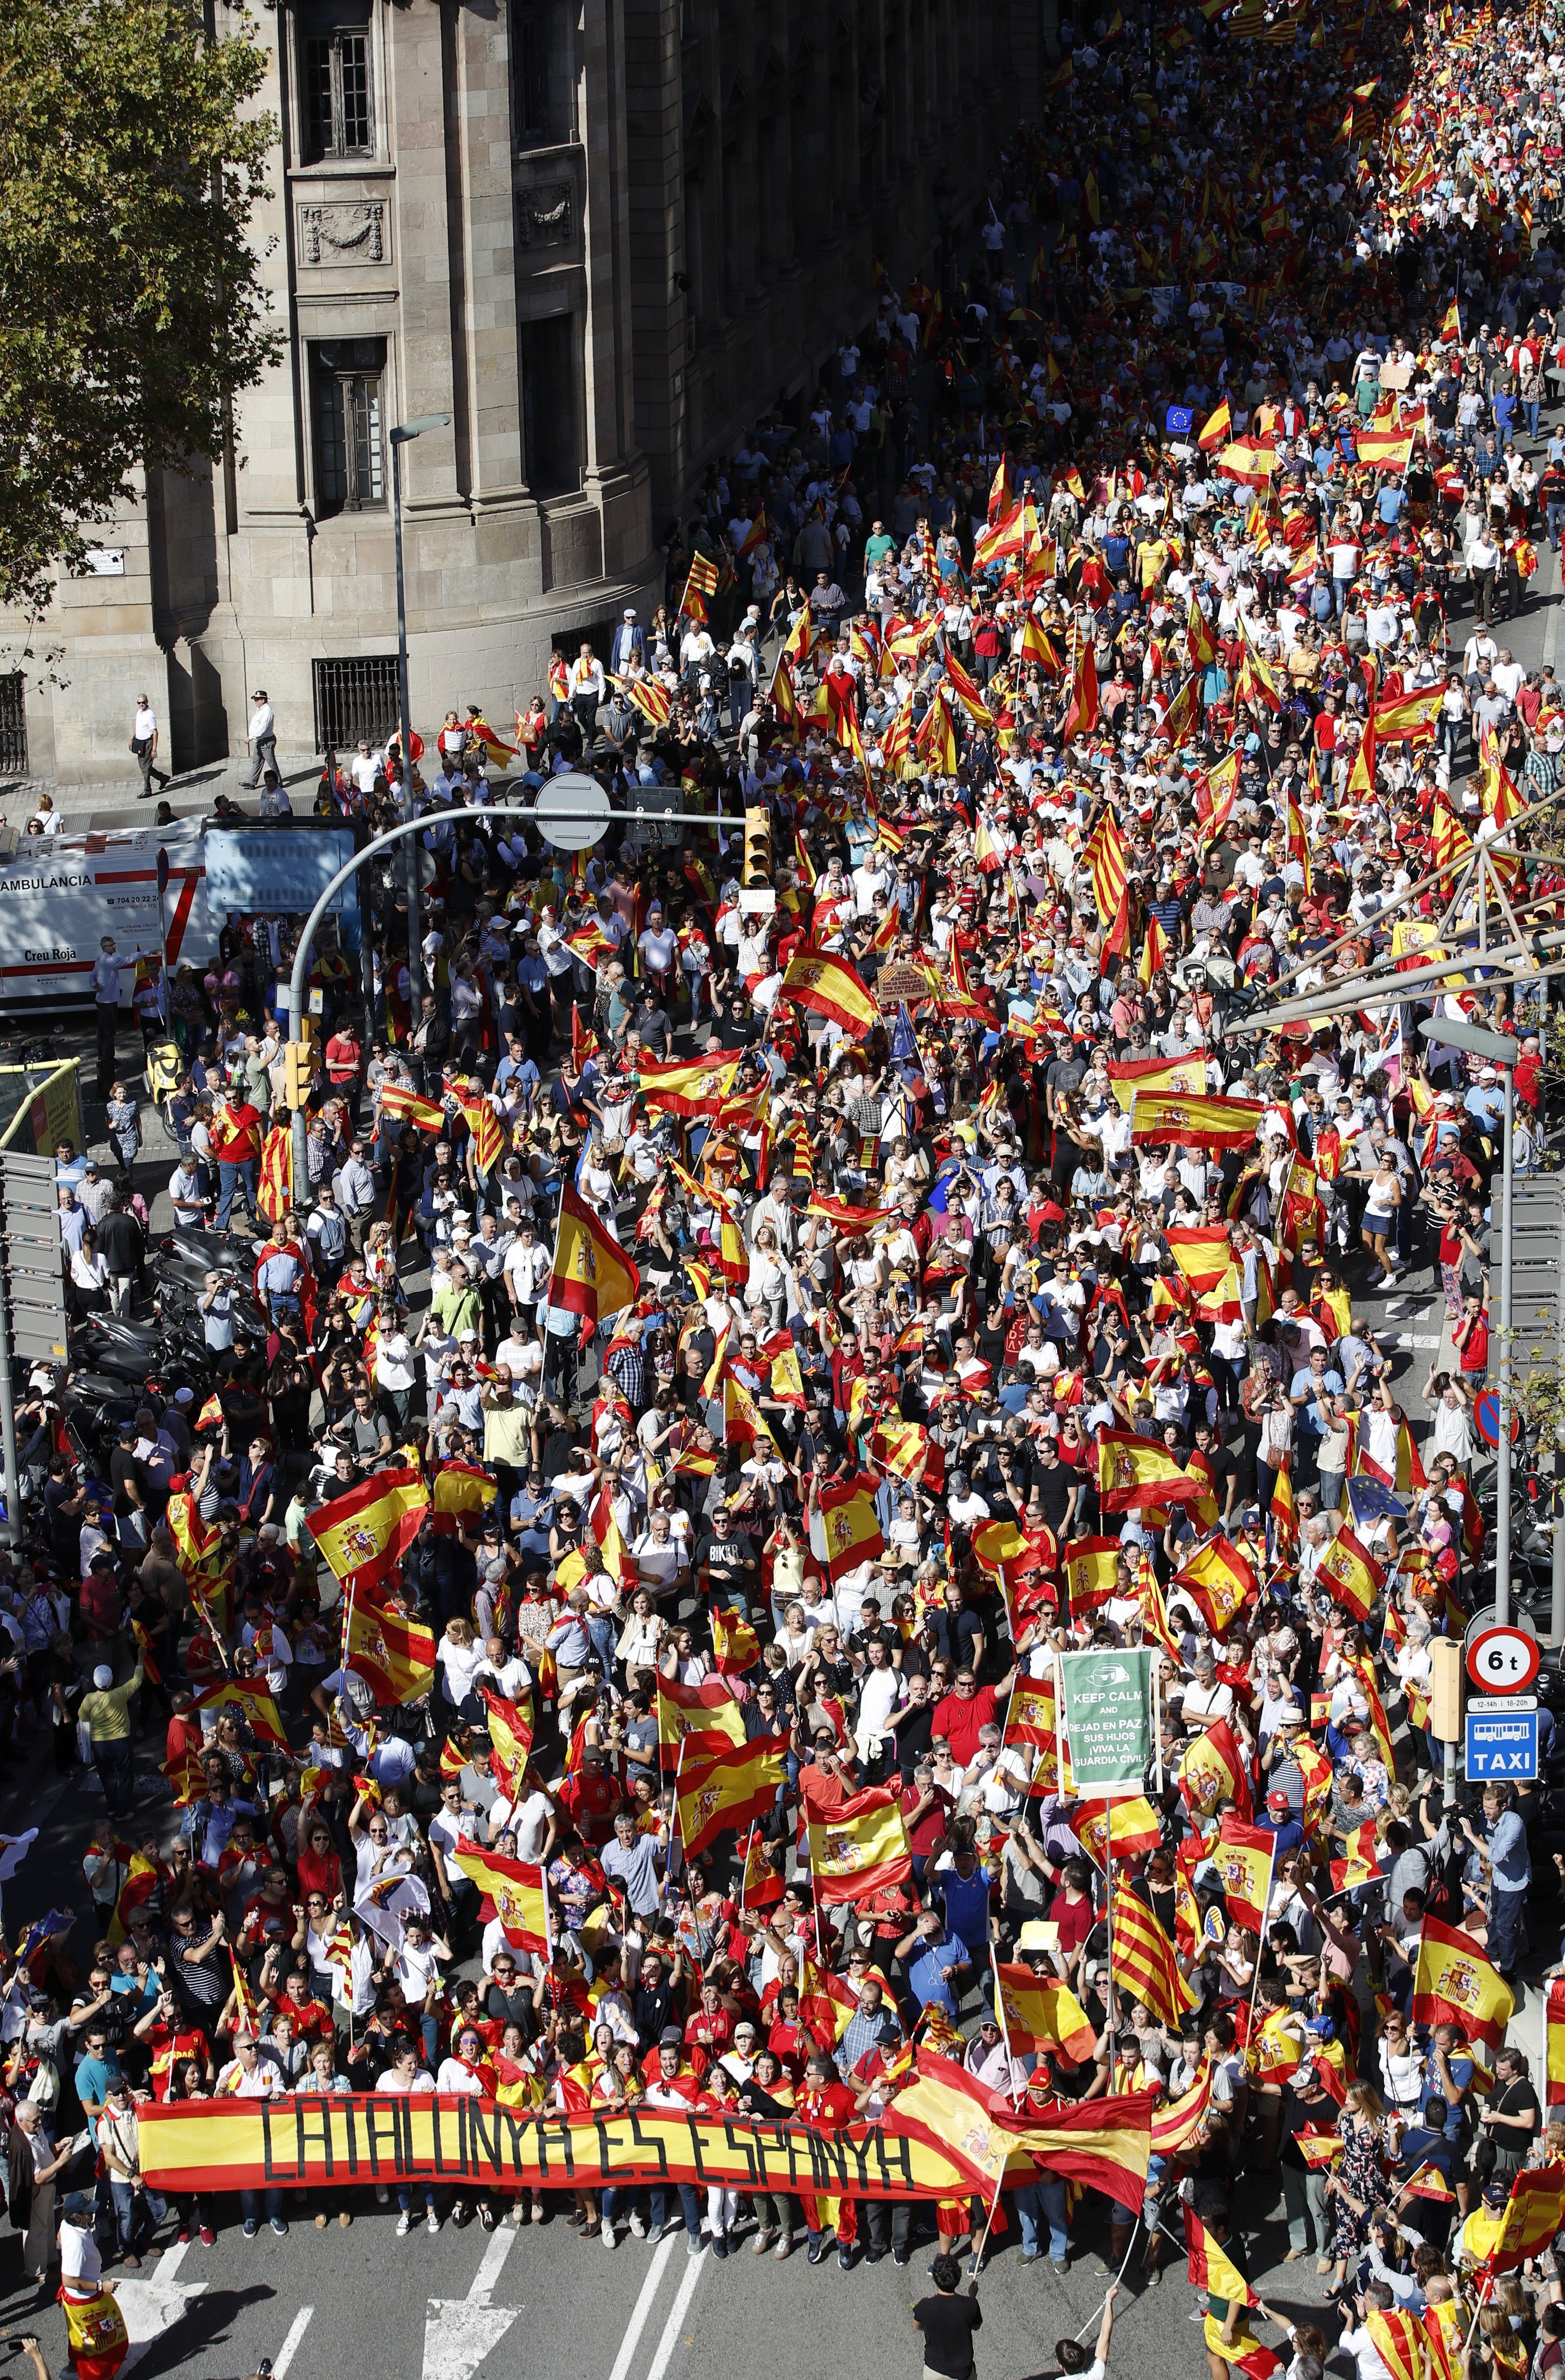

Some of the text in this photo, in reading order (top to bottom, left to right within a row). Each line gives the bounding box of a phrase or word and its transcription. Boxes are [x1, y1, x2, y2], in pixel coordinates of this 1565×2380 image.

[0, 875, 91, 892] AMBULÀNCIA
[25, 948, 76, 962] Creu Roja
[1488, 1651, 1518, 1670] 6 t
[1074, 1690, 1142, 1704] KEEP CALM
[1069, 1722, 1100, 1732] DEJAD
[1103, 1722, 1116, 1730] EN
[1119, 1719, 1142, 1729] PAZ
[1084, 1732, 1135, 1742] SUS HIJOS
[1090, 1743, 1130, 1756] ¡VIVA LA
[1074, 1753, 1146, 1767] GUARDIA CIVIL!
[1474, 1753, 1530, 1770] TAXI
[261, 2096, 915, 2191] CATALUNYA ES ESPANYA
